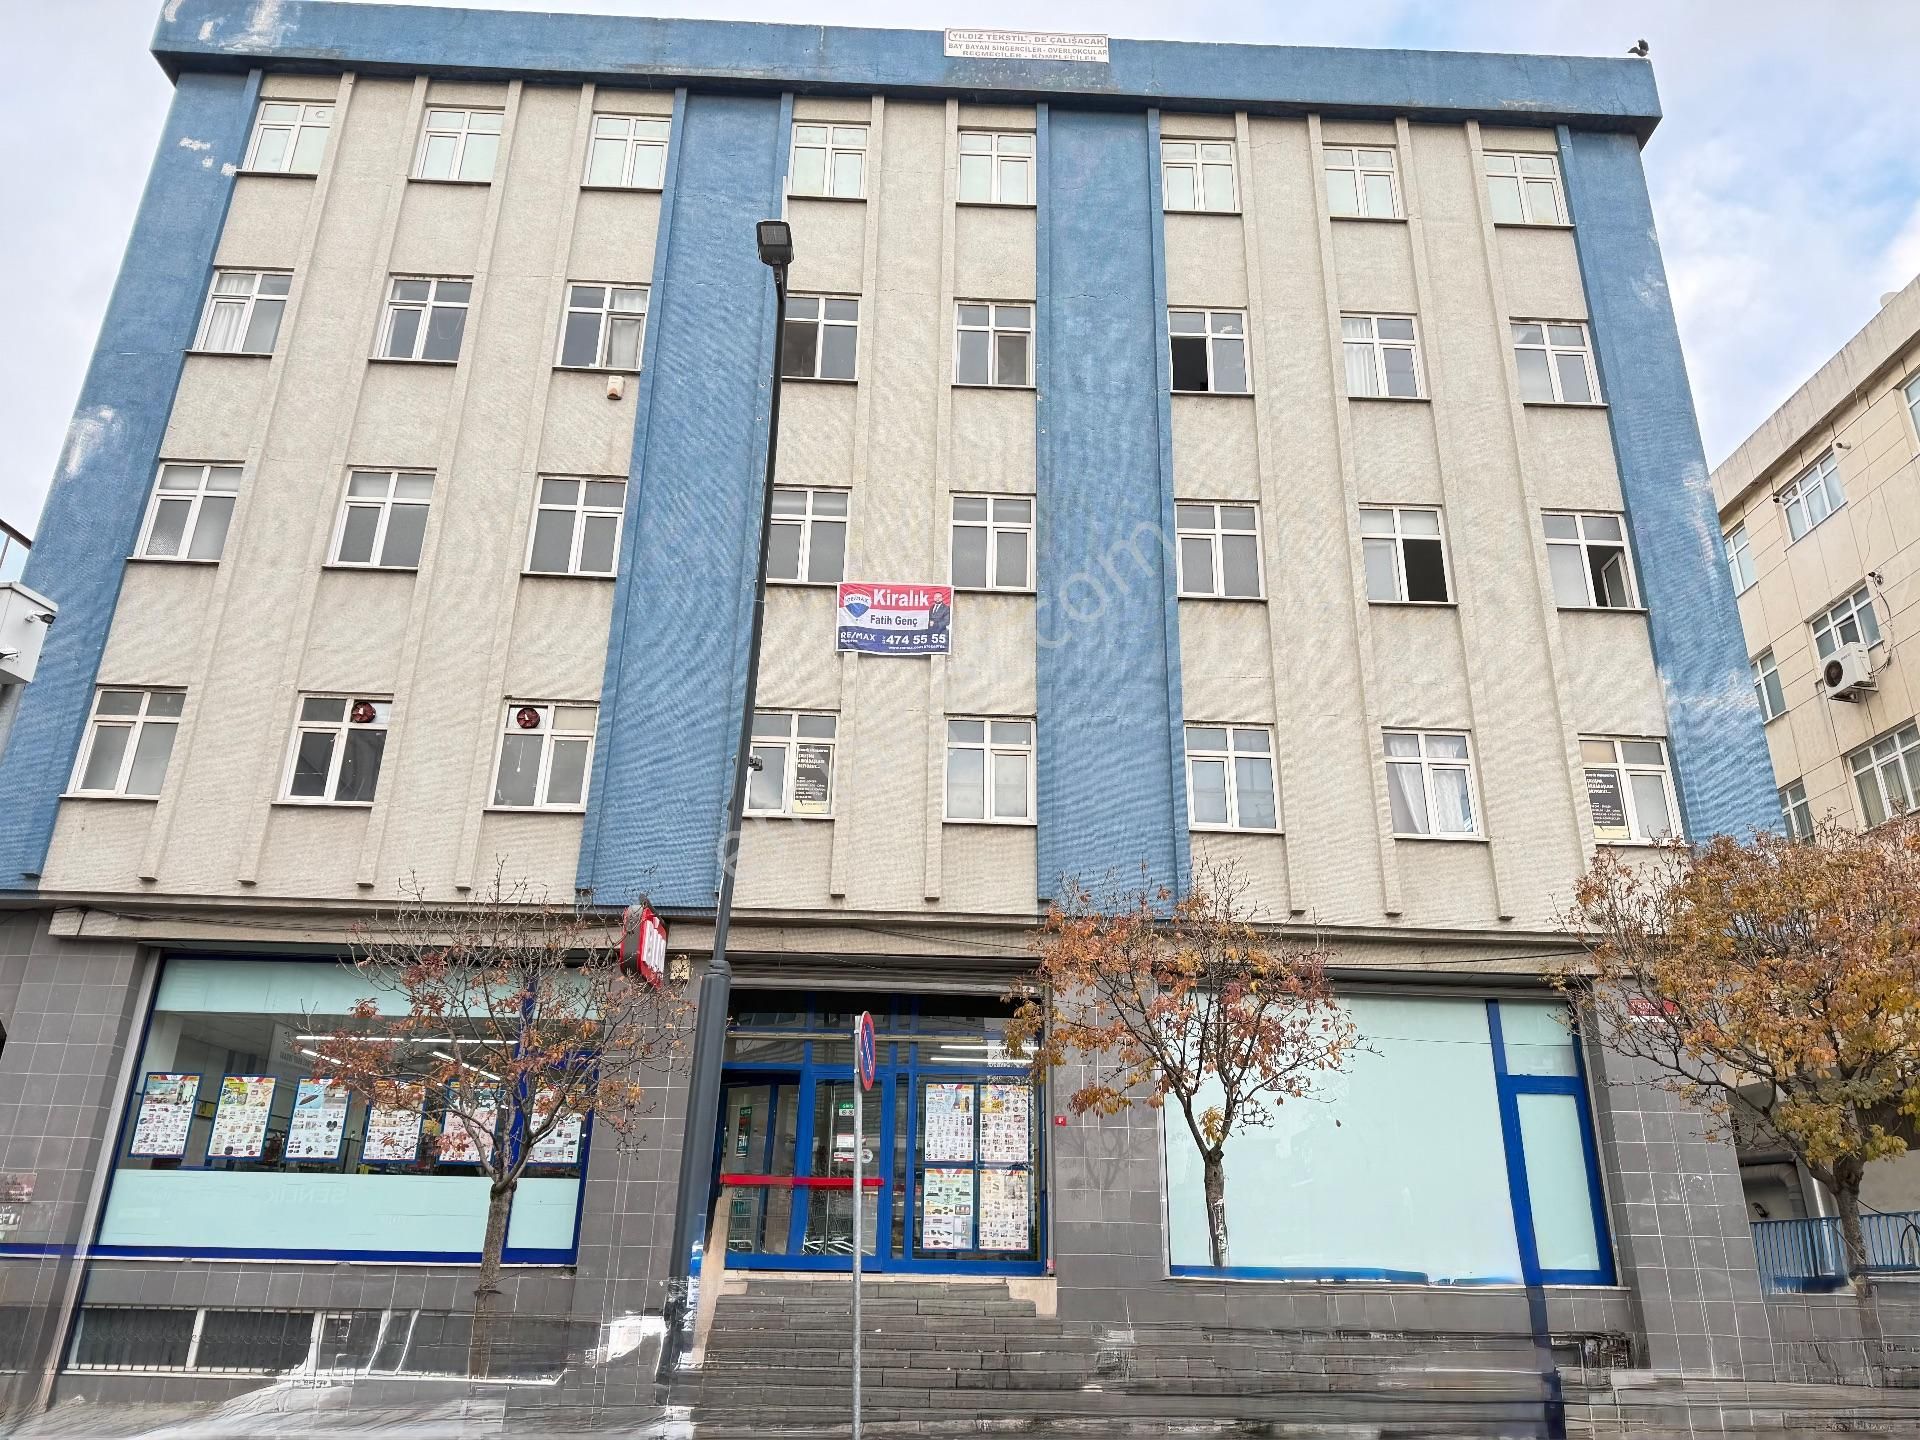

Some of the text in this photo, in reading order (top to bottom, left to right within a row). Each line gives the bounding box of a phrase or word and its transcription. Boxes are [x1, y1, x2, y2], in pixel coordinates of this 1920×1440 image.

[1050, 37, 1104, 45] ÇALIŞACAK
[873, 589, 929, 607] Kiralık
[870, 615, 918, 628] Fatih Genç
[840, 632, 875, 641] RE/MAX
[886, 634, 910, 645] 474
[913, 634, 928, 645] 55
[931, 633, 946, 643] 55
